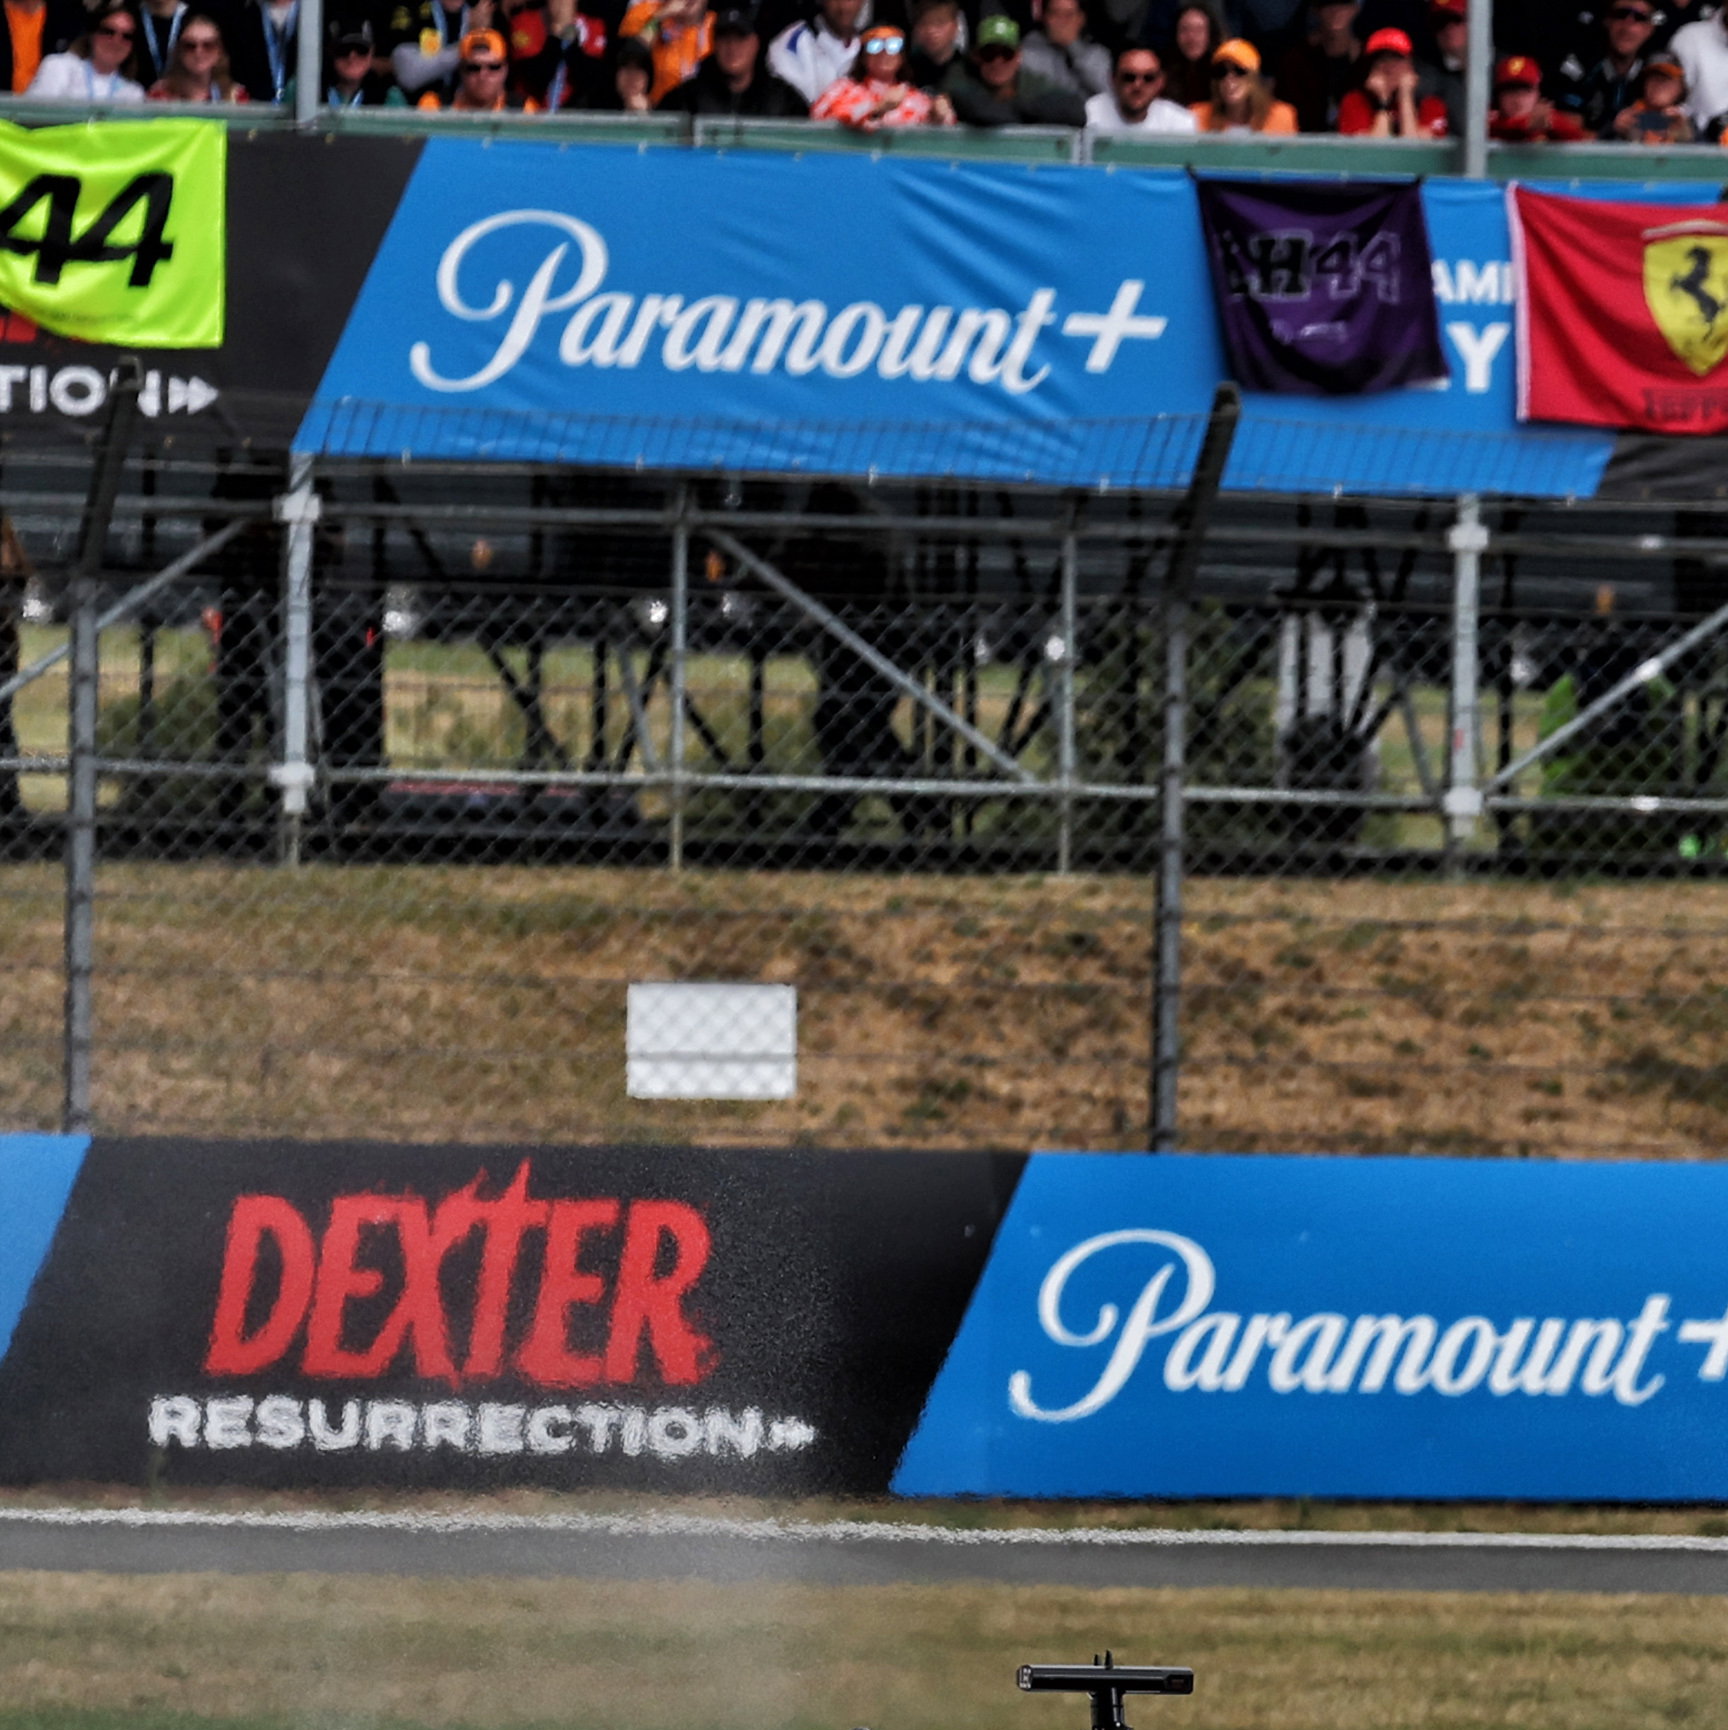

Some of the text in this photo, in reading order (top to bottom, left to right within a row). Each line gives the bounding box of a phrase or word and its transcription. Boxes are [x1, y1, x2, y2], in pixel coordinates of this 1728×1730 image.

[0, 173, 174, 287] 44
[410, 209, 1167, 392] Paramount+
[205, 1158, 716, 1387] DEXTER
[147, 1394, 763, 1460] RESURRECTION
